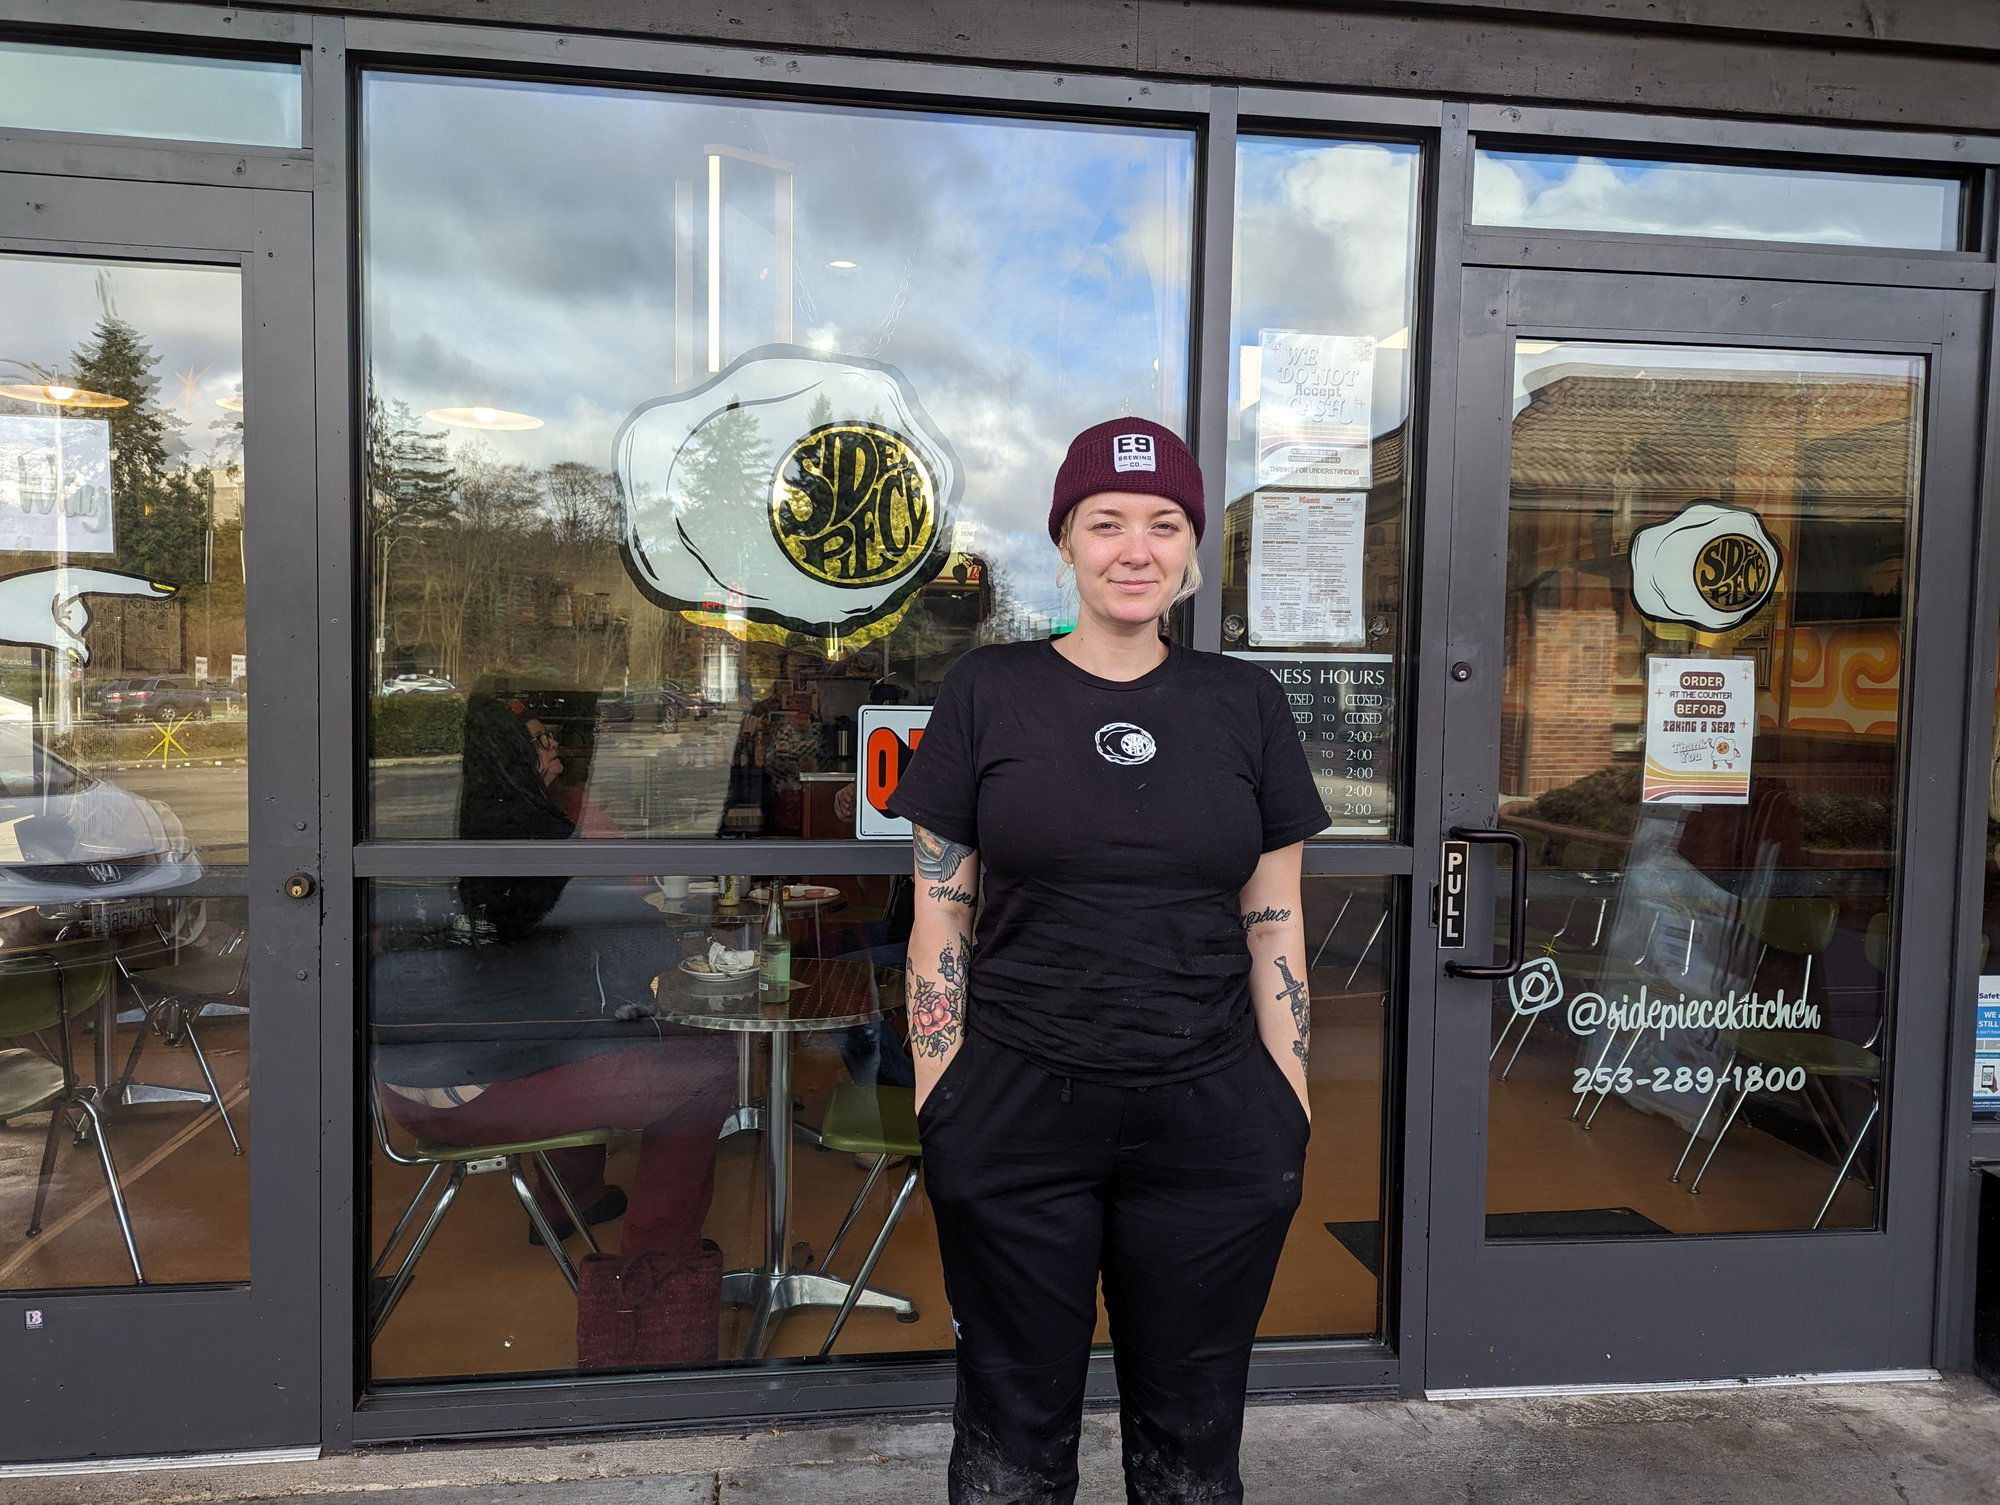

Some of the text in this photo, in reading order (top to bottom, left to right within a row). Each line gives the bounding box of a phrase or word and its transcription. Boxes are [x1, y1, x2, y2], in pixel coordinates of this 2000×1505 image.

[1286, 346, 1320, 366] WE
[1277, 366, 1360, 387] DO NOT
[1295, 385, 1342, 398] Accept
[1288, 399, 1354, 424] CASH
[1118, 437, 1151, 453] E9
[1270, 669, 1385, 685] NESS HOURS
[1682, 676, 1723, 687] ORDER
[1286, 694, 1382, 706] OSED TO CLOSED
[1697, 691, 1733, 699] COUNTER
[1676, 704, 1725, 715] BEFORE
[1293, 712, 1382, 724] SED TO CLOSED
[1321, 730, 1373, 743] TO 2:00
[1321, 748, 1372, 761] TO 2:00
[1679, 752, 1703, 763] You
[1320, 766, 1373, 779] TO 2:00
[1320, 785, 1373, 797] TO 2:00
[1344, 803, 1372, 815] 2:00
[1446, 852, 1463, 938] PULL
[1567, 985, 1821, 1041] @sidepiecekitchen
[1984, 1011, 1997, 1019] WE
[1978, 1020, 2000, 1028] STILL
[1572, 1066, 1806, 1094] 253-289-1800
